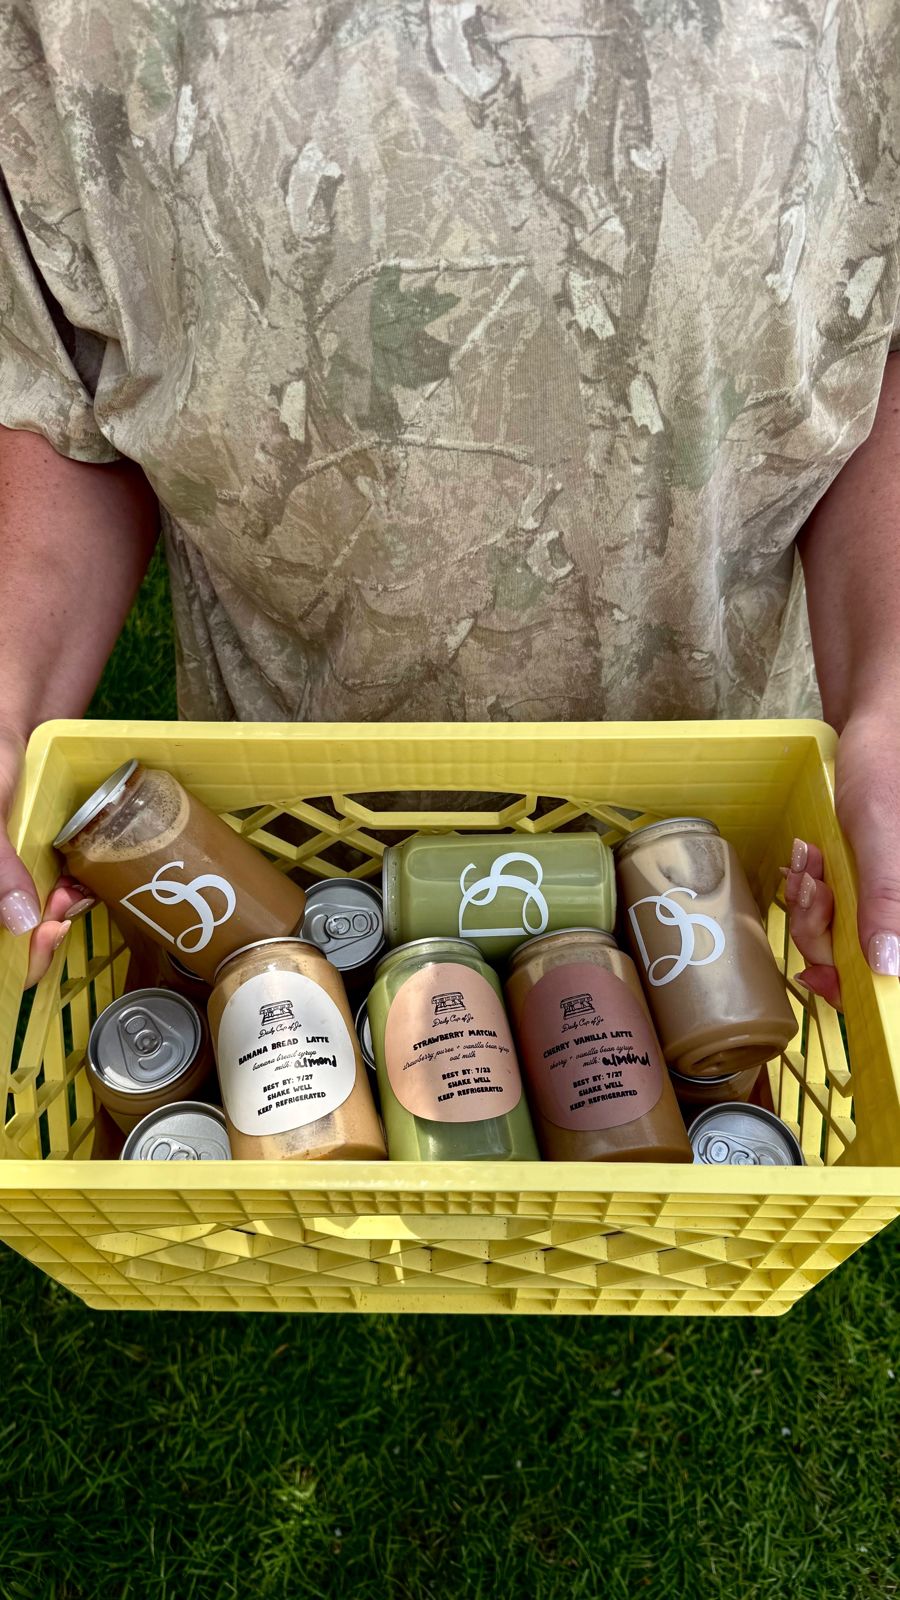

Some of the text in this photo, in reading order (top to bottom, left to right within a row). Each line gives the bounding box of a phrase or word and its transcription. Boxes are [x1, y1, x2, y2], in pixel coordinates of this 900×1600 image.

[432, 1018, 450, 1028] Daily
[561, 1023, 579, 1034] Daily
[258, 1026, 275, 1039] Daily
[413, 1029, 498, 1051] STRAWBERRY MATCHA
[238, 1036, 330, 1066] BANANA BREAD LATTE
[543, 1030, 633, 1059] CHERRY VANILLA LATTE
[575, 1047, 598, 1060] vanilla
[599, 1045, 615, 1054] bean
[616, 1044, 634, 1054] syrup
[252, 1050, 317, 1071] banana bread syrup
[294, 1055, 337, 1067] almond
[402, 1052, 435, 1071] strawberry
[433, 1045, 455, 1059] puree
[462, 1041, 485, 1050] vanilla
[485, 1041, 498, 1050] bean
[449, 1051, 476, 1062] oat milk
[582, 1052, 651, 1068] milk: almond
[441, 1070, 459, 1081] BEST
[461, 1068, 474, 1076] BY:
[447, 1076, 491, 1089] SHAKE WELL
[573, 1071, 623, 1088] BEST BY: 7/27
[263, 1074, 314, 1093] BEST BY: 7/27
[578, 1081, 624, 1097] SHAKE WELL
[267, 1083, 313, 1101] SHAKE WELL
[437, 1086, 503, 1102] KEEP REFRIGERATED
[257, 1091, 327, 1116] KEEP REFRIGERATED
[569, 1089, 638, 1112] KEEP REFRIGERATED
